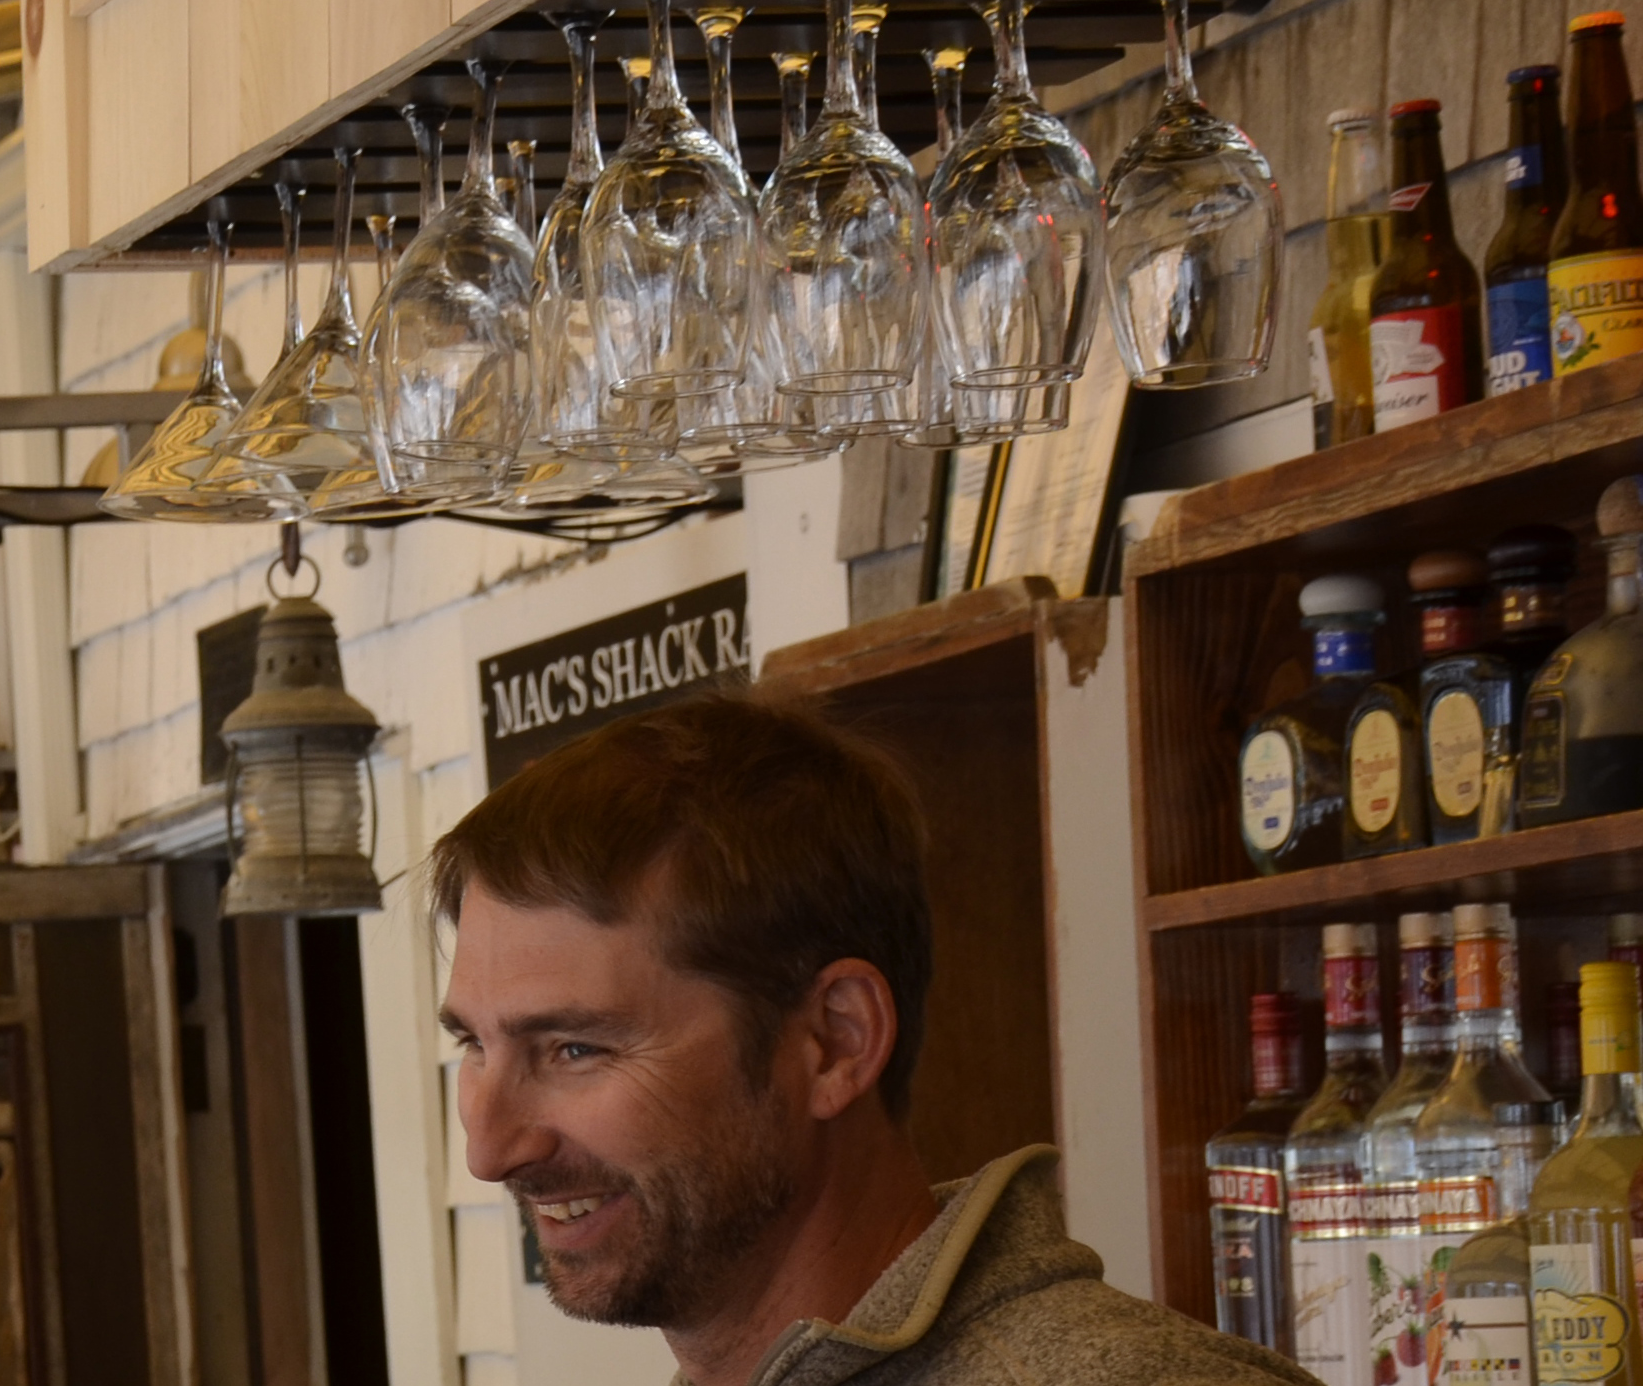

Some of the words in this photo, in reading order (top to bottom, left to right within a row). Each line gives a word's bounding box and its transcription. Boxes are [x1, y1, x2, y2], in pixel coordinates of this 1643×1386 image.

[492, 654, 588, 739] MAC'S
[591, 615, 710, 709] SHACK
[1552, 1315, 1606, 1340] EDDY
